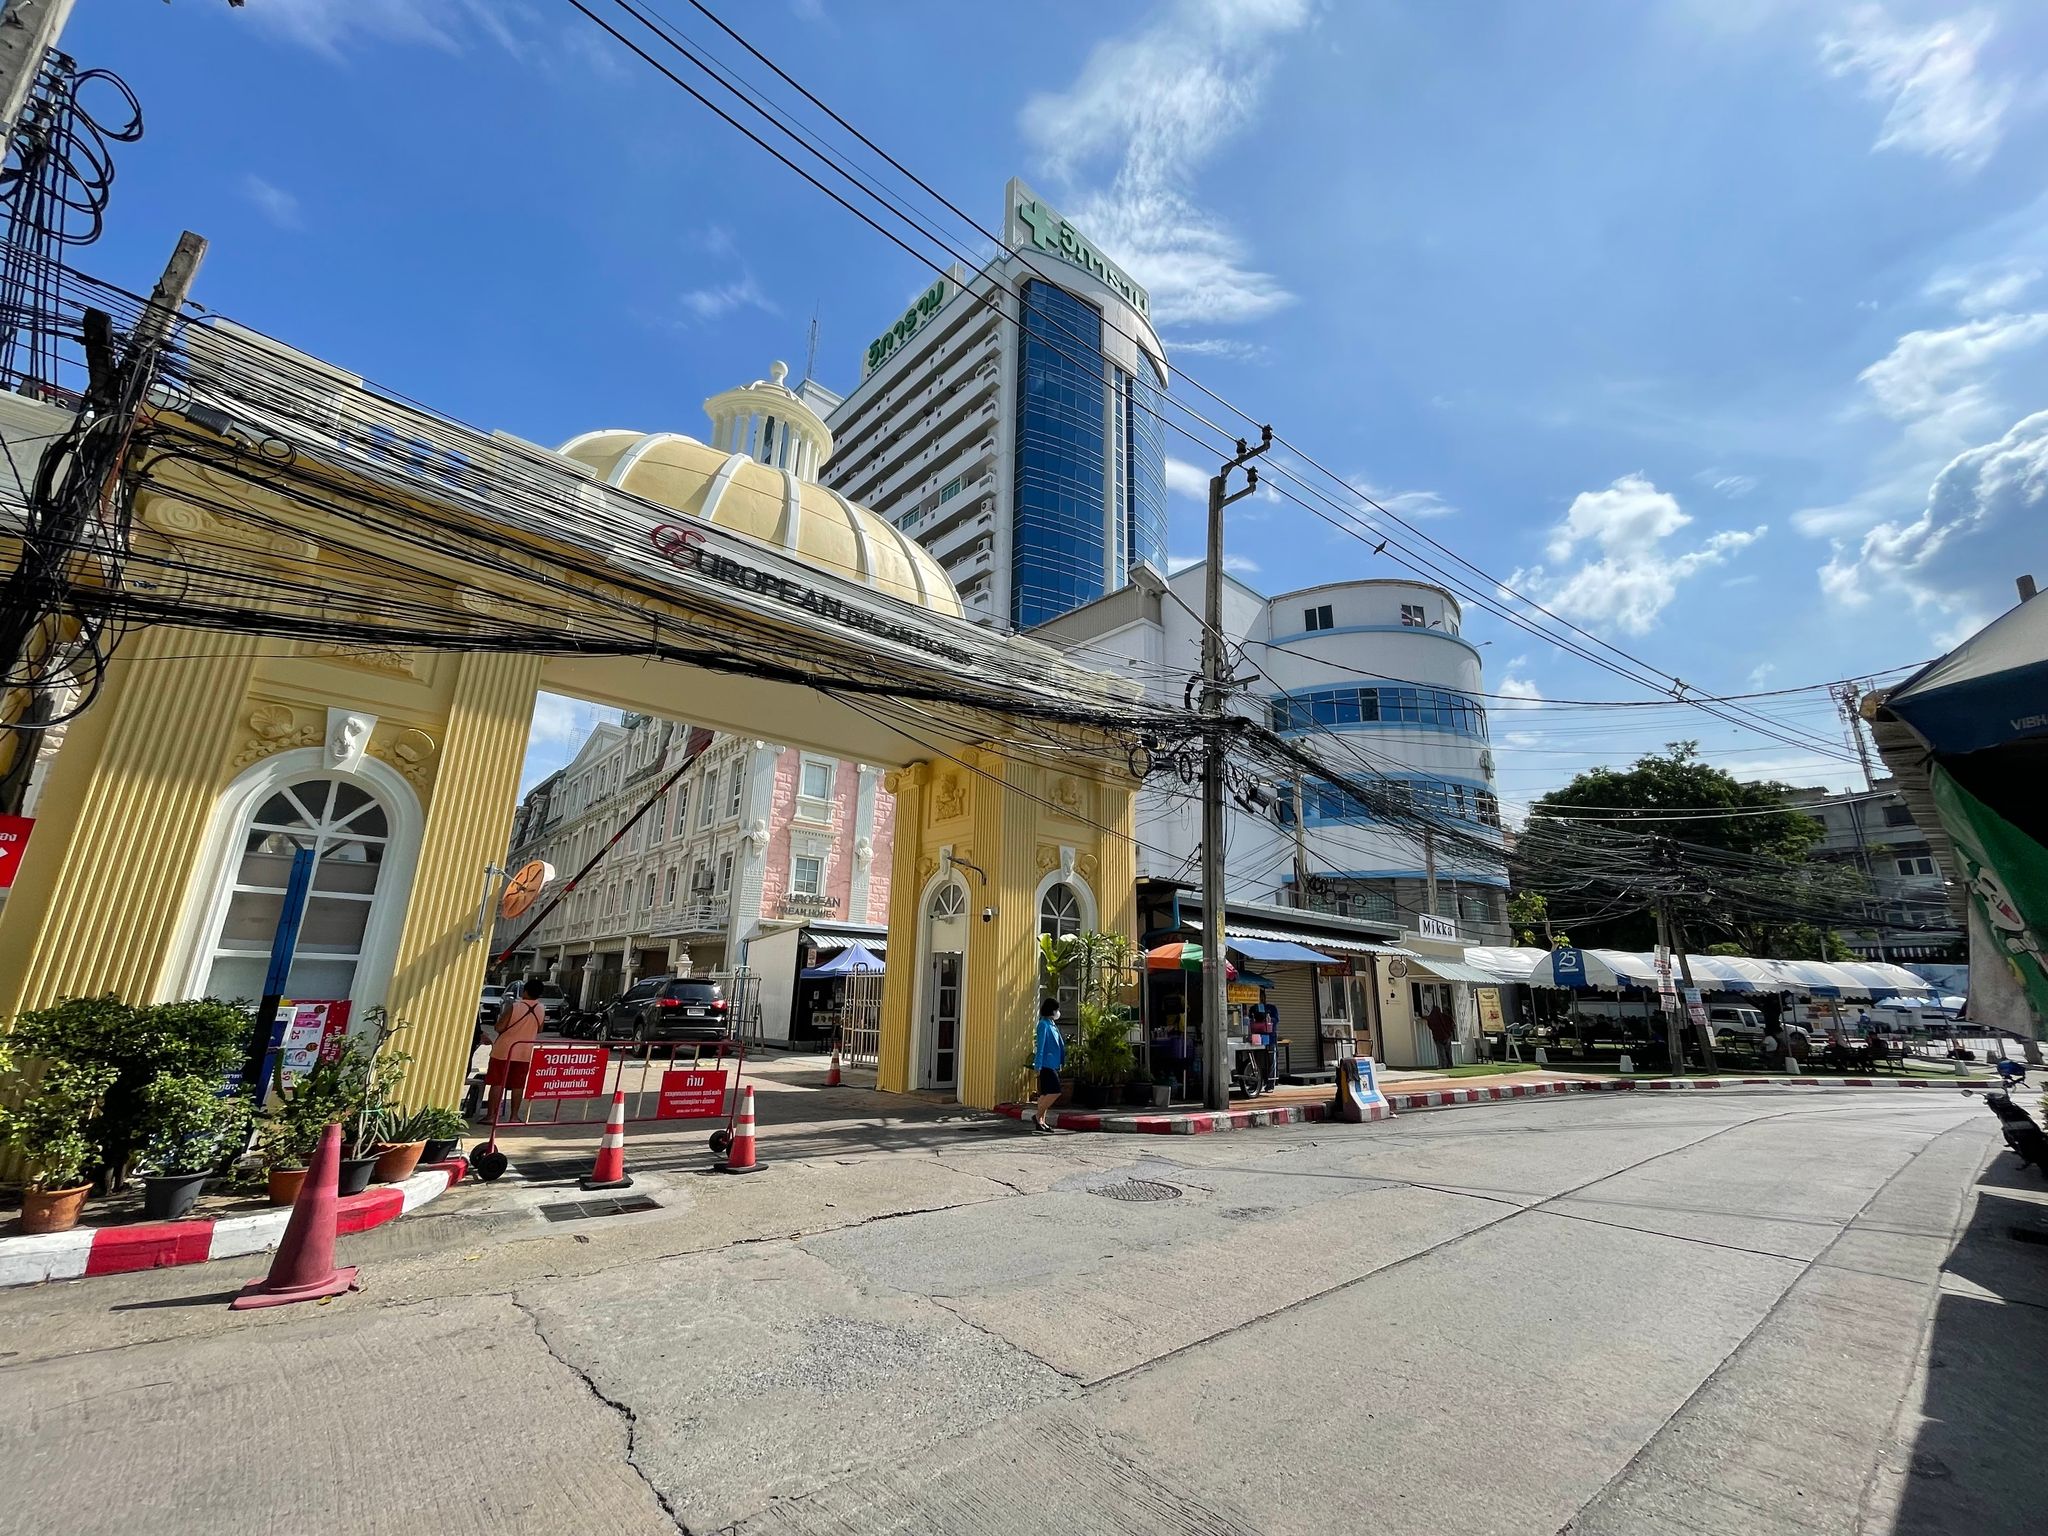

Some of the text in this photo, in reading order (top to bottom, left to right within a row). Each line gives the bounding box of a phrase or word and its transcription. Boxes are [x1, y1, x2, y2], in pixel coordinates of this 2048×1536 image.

[1423, 919, 1453, 936] Mikka
[1559, 951, 1577, 967] 25
[544, 1054, 597, 1064] จอดเฉพาะ
